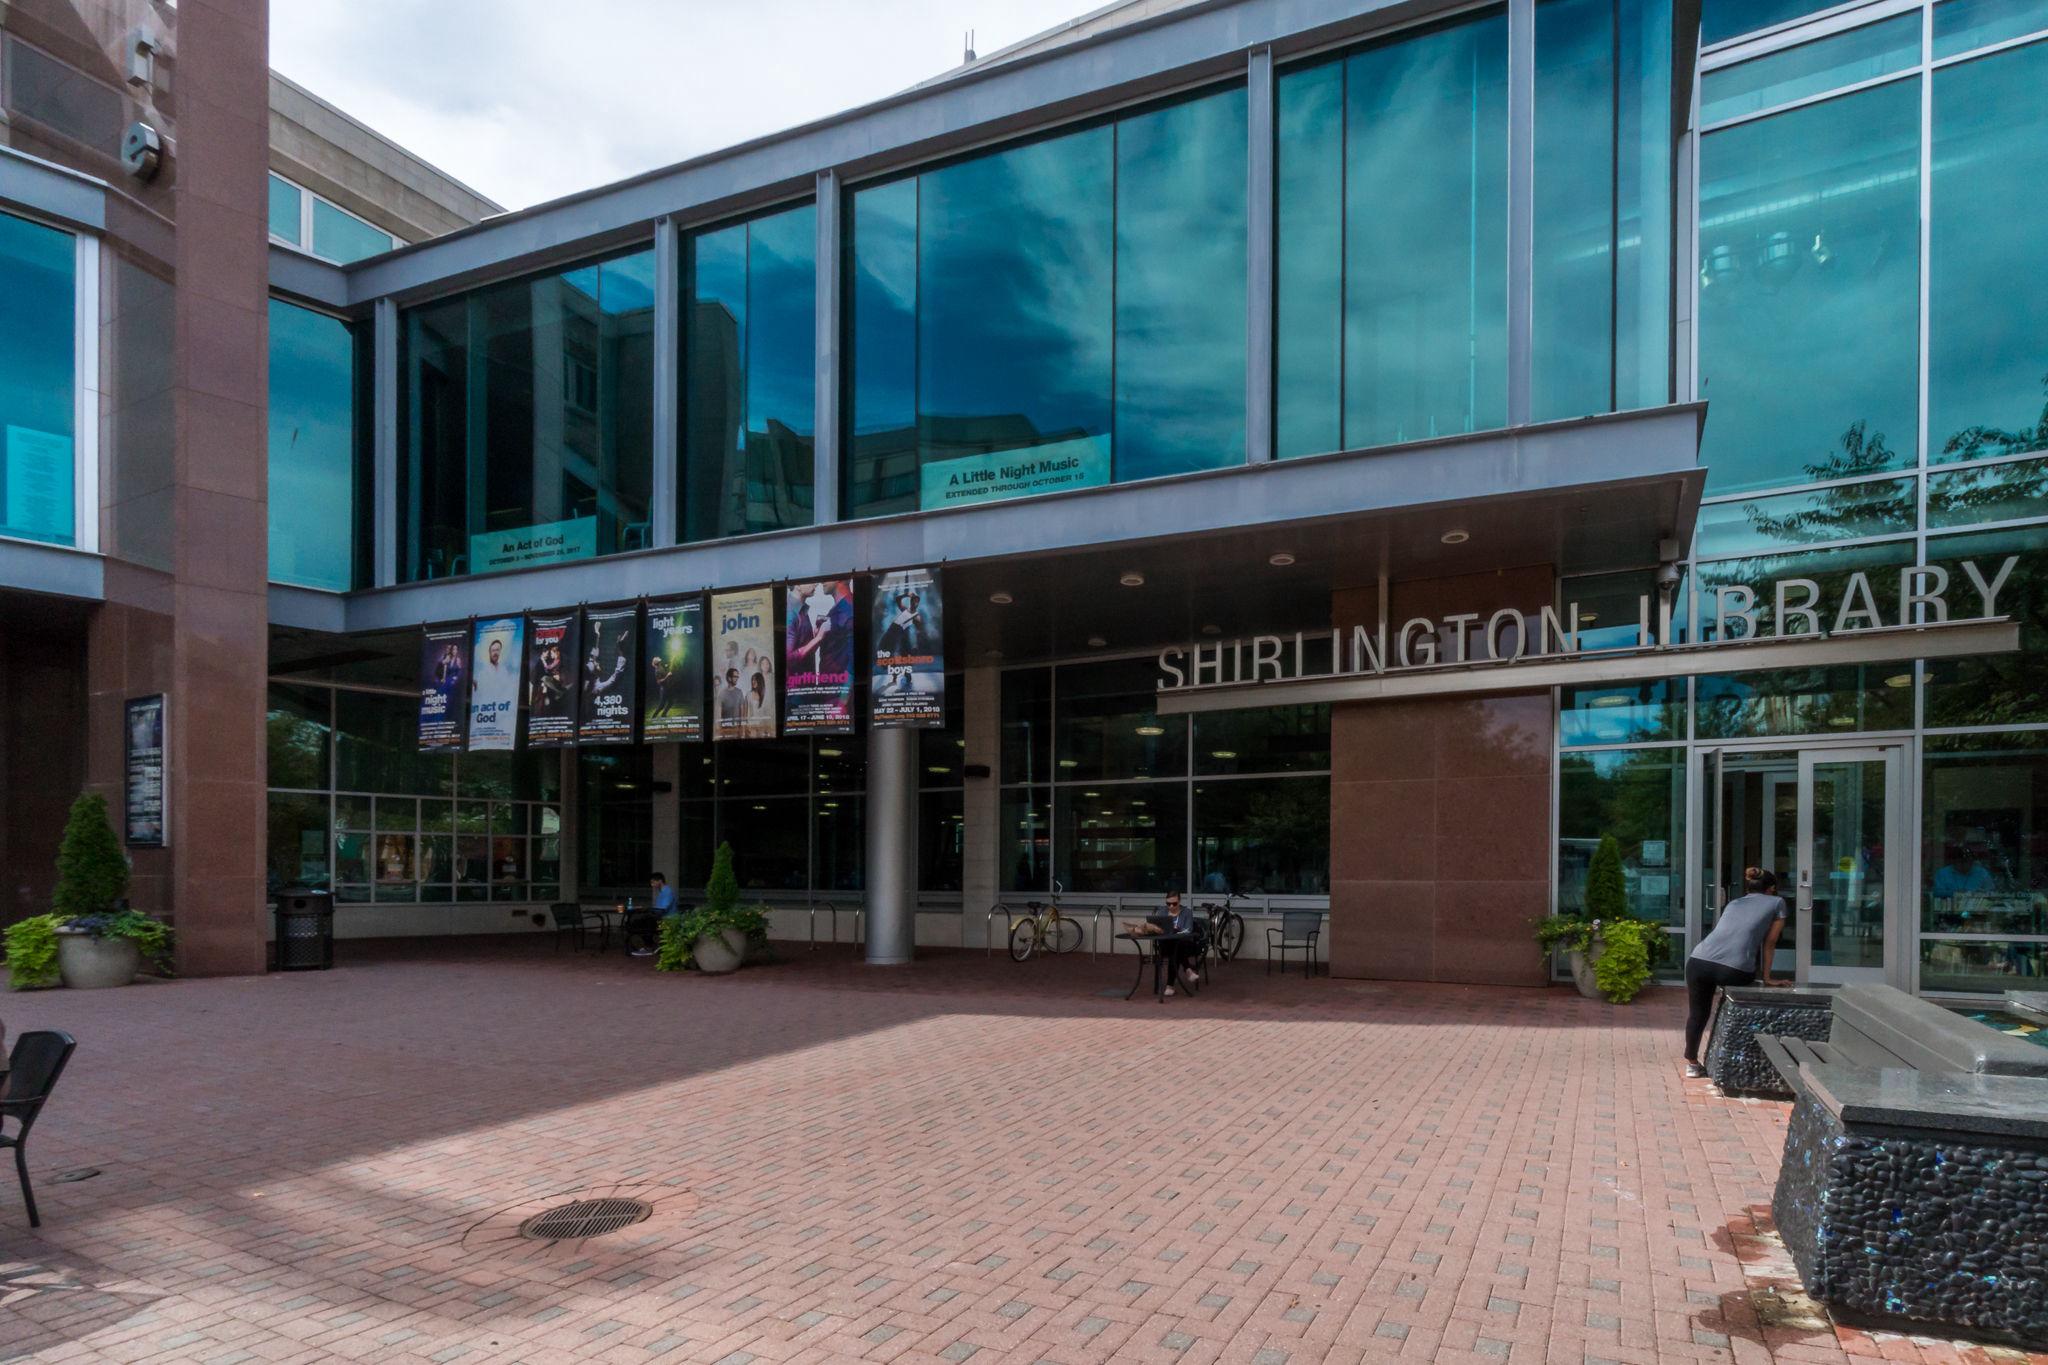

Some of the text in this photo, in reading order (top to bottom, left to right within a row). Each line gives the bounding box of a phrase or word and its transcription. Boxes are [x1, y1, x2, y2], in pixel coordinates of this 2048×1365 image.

[949, 457, 1080, 486] A Little Night Music
[945, 487, 988, 500] EXTENDED
[991, 482, 1031, 493] THROUGH
[1032, 475, 1072, 487] OCTOBER
[502, 534, 564, 553] An Act of God
[652, 616, 674, 630] light
[720, 612, 760, 635] john
[1157, 555, 2020, 689] SHIRLINGTON LIBRARY
[663, 625, 693, 638] years
[877, 649, 891, 658] the
[888, 664, 912, 675] boys
[788, 670, 849, 688] girlfriend
[424, 694, 447, 706] night
[480, 701, 496, 712] act
[498, 700, 511, 711] of
[594, 694, 622, 707] 4,380
[421, 704, 446, 714] music
[597, 705, 628, 717] nights
[476, 712, 496, 723] God
